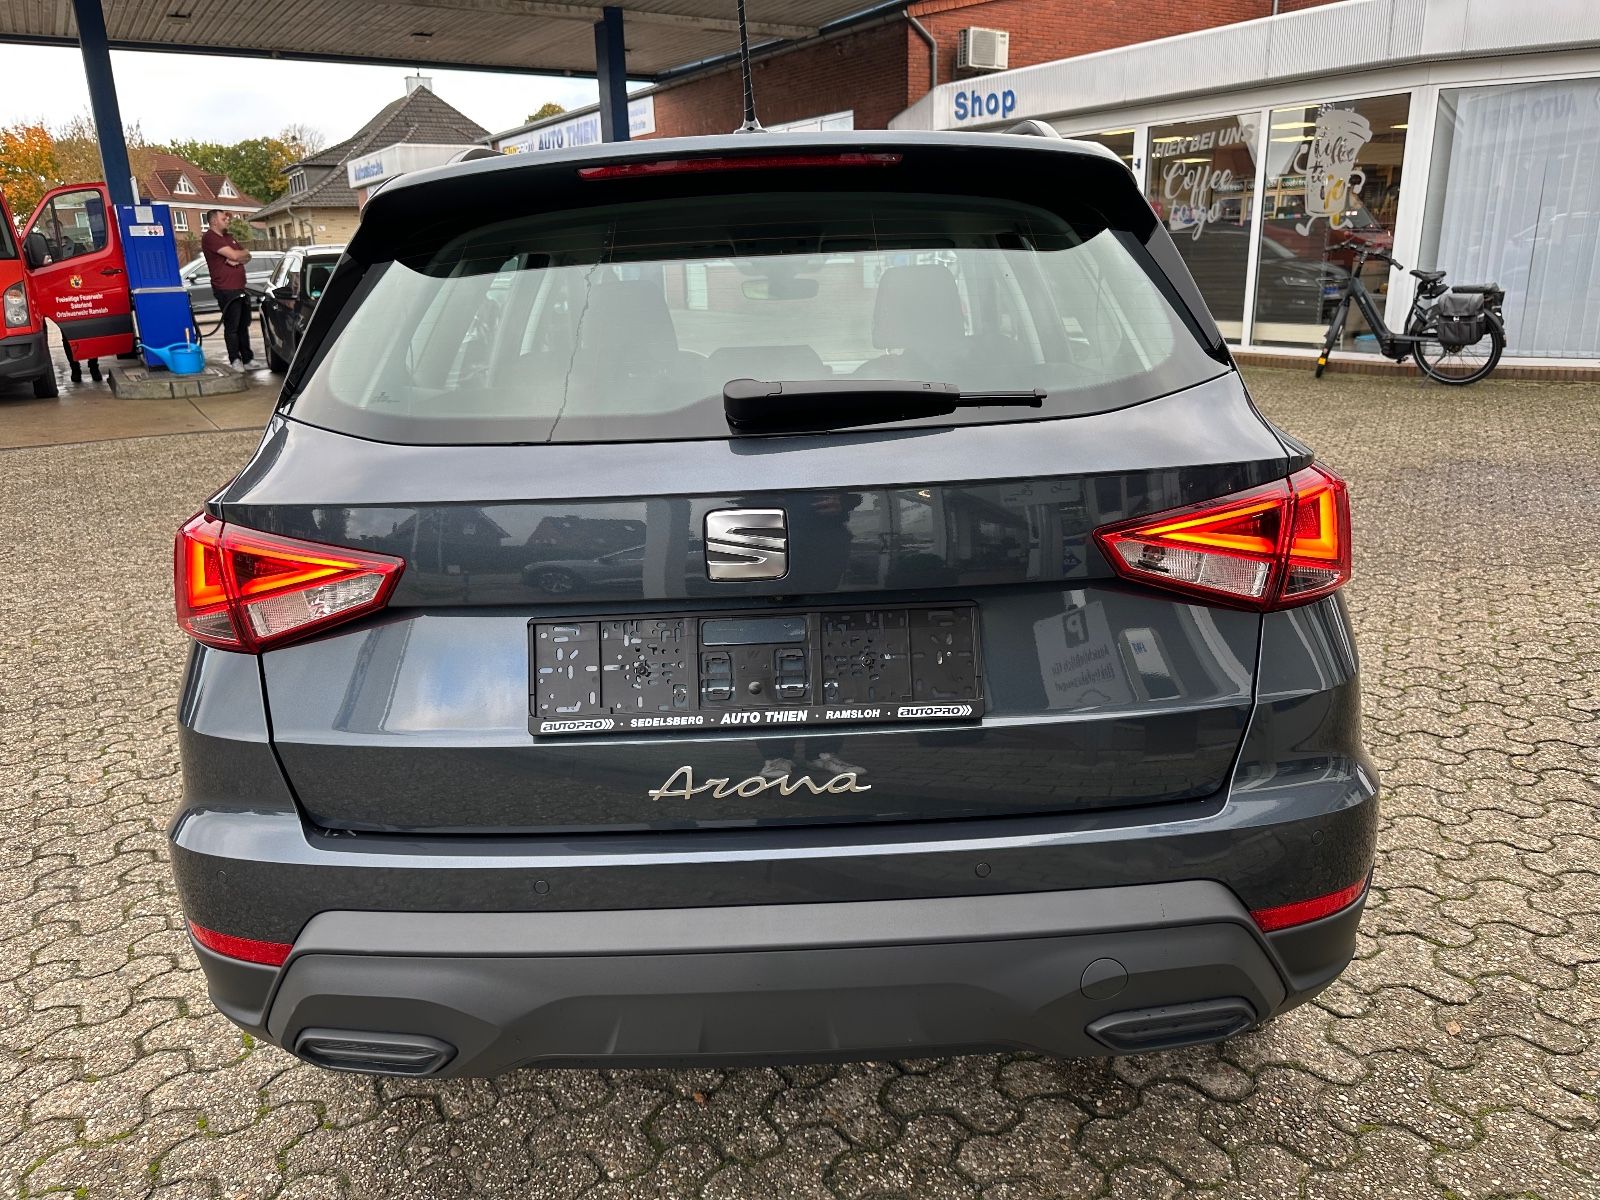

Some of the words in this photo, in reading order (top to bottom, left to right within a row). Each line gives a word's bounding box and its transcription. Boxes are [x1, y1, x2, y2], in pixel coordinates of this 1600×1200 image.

[954, 89, 1016, 120] Shop
[538, 128, 564, 151] AUTO
[566, 118, 599, 147] THIEN
[1154, 140, 1188, 158] HIER
[1189, 131, 1216, 153] BEI
[1218, 123, 1255, 146] UNS
[1163, 162, 1233, 208] Coffee
[630, 715, 704, 728] SEDELSBERG
[720, 712, 761, 725] AUTO
[764, 710, 808, 723] THIEN
[825, 708, 881, 720] RAMSLOH
[648, 765, 872, 801] Arona
